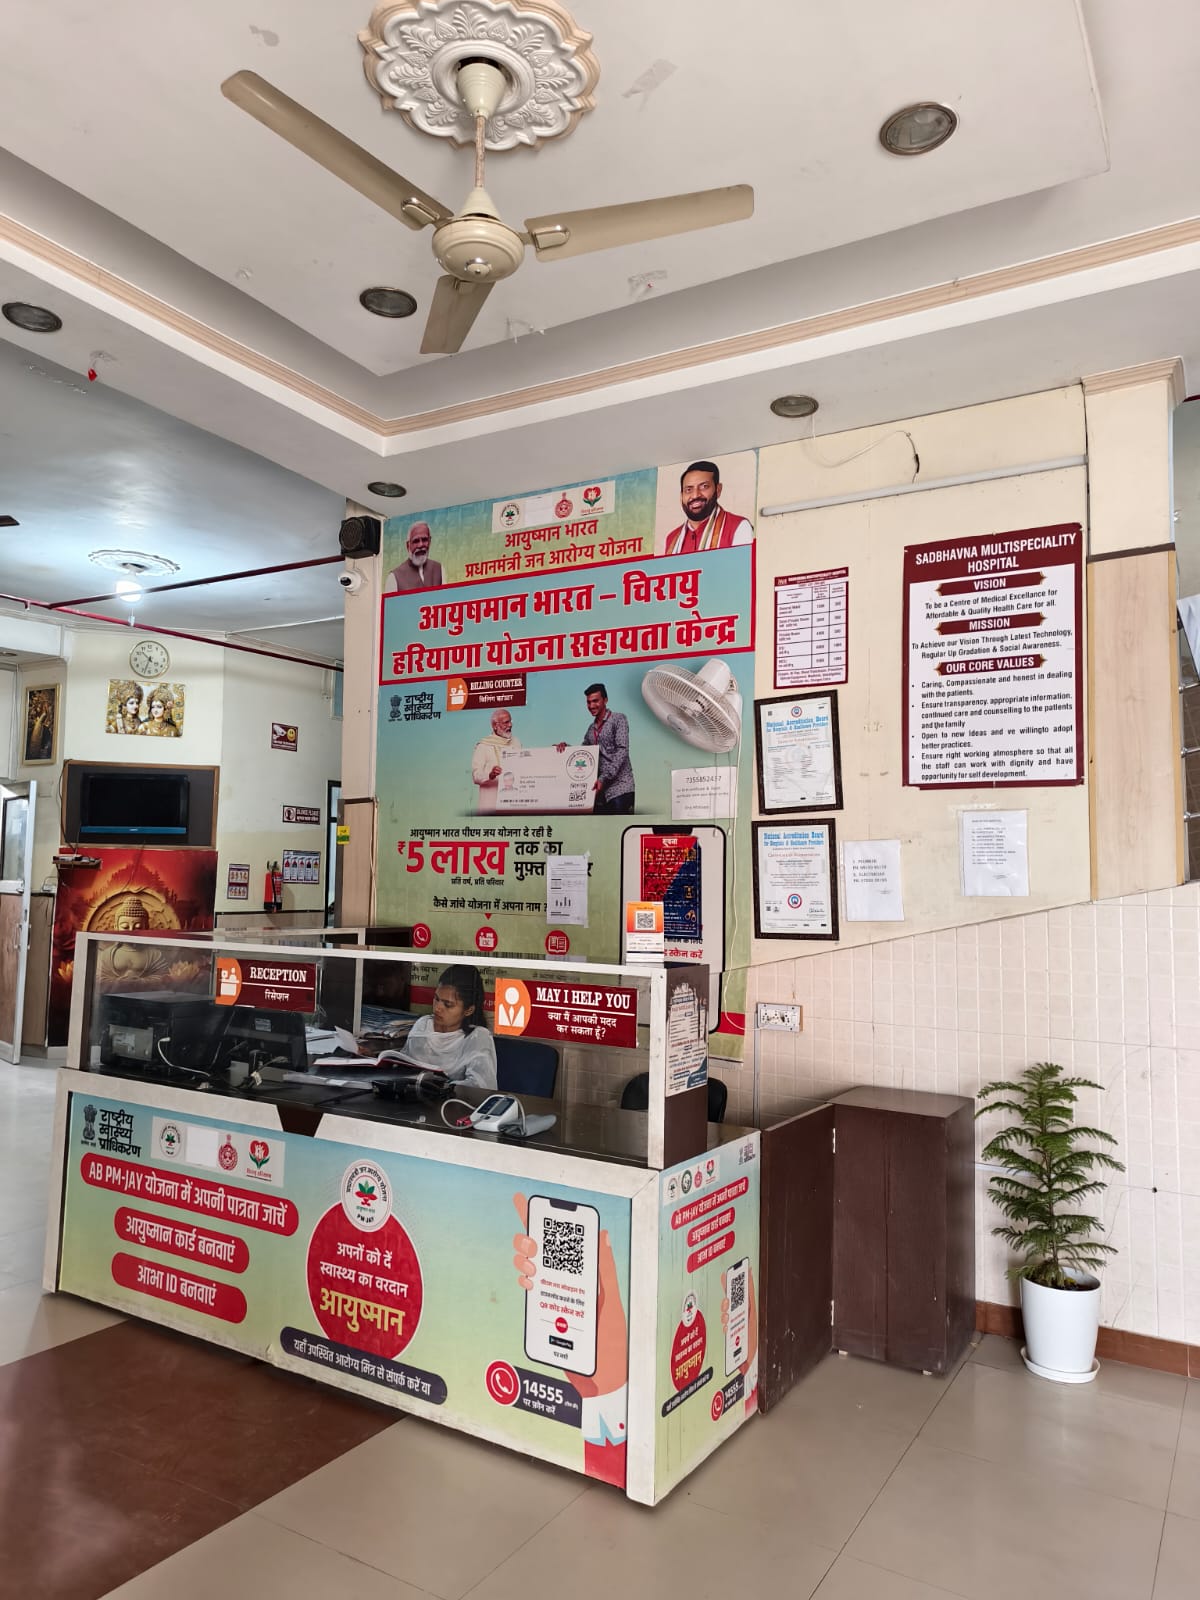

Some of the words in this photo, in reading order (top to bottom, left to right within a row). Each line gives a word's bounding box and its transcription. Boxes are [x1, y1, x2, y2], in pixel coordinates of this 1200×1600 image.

[505, 527, 560, 550] आयुष्मान
[565, 519, 598, 540] भारत
[465, 551, 521, 578] प्रधानमंत्री
[525, 553, 545, 570] जन
[548, 546, 594, 566] आरोग्य
[599, 536, 642, 557] योजना
[916, 546, 978, 565] SADBHAVNA
[981, 533, 1076, 557] MULTISPECIALITY
[968, 557, 1019, 573] HOSPITAL
[974, 578, 1006, 591] VISION
[418, 593, 528, 636] आयुषमान
[533, 584, 594, 617] भारत
[622, 569, 701, 610] चिरायु
[950, 599, 970, 607] Centre
[981, 595, 1007, 603] Medical
[926, 610, 958, 619] Affordable
[968, 604, 991, 616] Quality
[993, 603, 1015, 612] Health
[969, 617, 1010, 630] MISSION
[392, 643, 481, 676] हरियाणा
[486, 632, 565, 665] योजना
[570, 622, 672, 658] सहायता
[675, 611, 739, 647] केन्द्र
[920, 640, 945, 649] Achieve
[960, 637, 979, 645] Vision
[982, 635, 1009, 644] Through
[1011, 632, 1031, 641] Latest
[922, 650, 946, 659] Regular
[948, 650, 957, 658] Up
[959, 646, 990, 655] Gradation
[1000, 644, 1021, 652] Social
[946, 663, 966, 673] OUR
[968, 660, 994, 671] CORE
[997, 657, 1034, 668] VALUES
[470, 681, 493, 690] BILLING
[494, 678, 522, 689] COUNTER
[946, 677, 996, 687] Compassionate
[1047, 671, 1072, 681] dealing
[922, 711, 952, 719] continued
[984, 706, 1022, 715] counselling
[1044, 703, 1072, 712] patients
[410, 828, 440, 840] आयुष्मान
[441, 828, 460, 838] भारत
[462, 827, 481, 837] पीएम
[483, 828, 496, 837] जय
[498, 827, 521, 837] योजना
[522, 827, 530, 838] दे
[531, 825, 544, 837] रही
[545, 825, 553, 837] है
[515, 841, 539, 856] तक
[543, 841, 562, 856] का
[429, 840, 510, 875] लाख
[433, 896, 448, 910] कैसे
[449, 896, 465, 910] जांचे
[467, 897, 491, 910] योजना
[493, 898, 501, 911] में
[502, 900, 524, 911] अपना
[526, 901, 541, 912] नाम
[690, 949, 703, 959] करें
[250, 966, 307, 983] RECEPTION
[536, 987, 561, 1003] MAY
[563, 990, 569, 1004] I
[571, 991, 602, 1006] HELP
[605, 993, 631, 1009] YOU
[547, 1011, 561, 1020] क्या
[573, 1013, 598, 1025] आपकी
[600, 1017, 617, 1028] मदद
[556, 1024, 568, 1034] कर
[571, 1027, 593, 1036] सकता
[89, 1161, 103, 1180] AB
[105, 1166, 143, 1190] PM-JAY
[145, 1171, 179, 1200] योजना
[180, 1179, 193, 1202] में
[194, 1187, 225, 1212] अपनी
[227, 1195, 260, 1221] पात्रता
[262, 1202, 288, 1228] जाचें
[125, 1215, 173, 1243] आयुष्मान
[174, 1226, 196, 1251] कार्ड
[198, 1235, 235, 1263] बनवाएं
[337, 1242, 364, 1261] अपनों
[366, 1249, 381, 1265] को
[383, 1248, 393, 1270] दें
[138, 1265, 163, 1288] आभा
[165, 1273, 178, 1294] ID
[179, 1277, 217, 1306] बनवाएं
[320, 1261, 355, 1283] स्वास्थ्य
[358, 1271, 372, 1289] का
[375, 1275, 409, 1298] वरदान
[319, 1287, 406, 1336] आयुष्मान
[549, 1303, 560, 1312] कोड
[561, 1305, 574, 1315] स्कैन
[575, 1310, 584, 1318] करें
[294, 1337, 307, 1352] यहाँ
[307, 1343, 334, 1364] उपस्थित
[335, 1352, 360, 1371] आरोग्य
[360, 1360, 376, 1377] मित्र
[377, 1366, 385, 1378] से
[386, 1368, 406, 1391] संपर्क
[407, 1375, 422, 1392] करें
[422, 1382, 431, 1396] या
[675, 1350, 702, 1380] आयुष्मान
[522, 1379, 564, 1405] 14555
[523, 1398, 531, 1407] पर
[545, 1404, 556, 1415] करें
